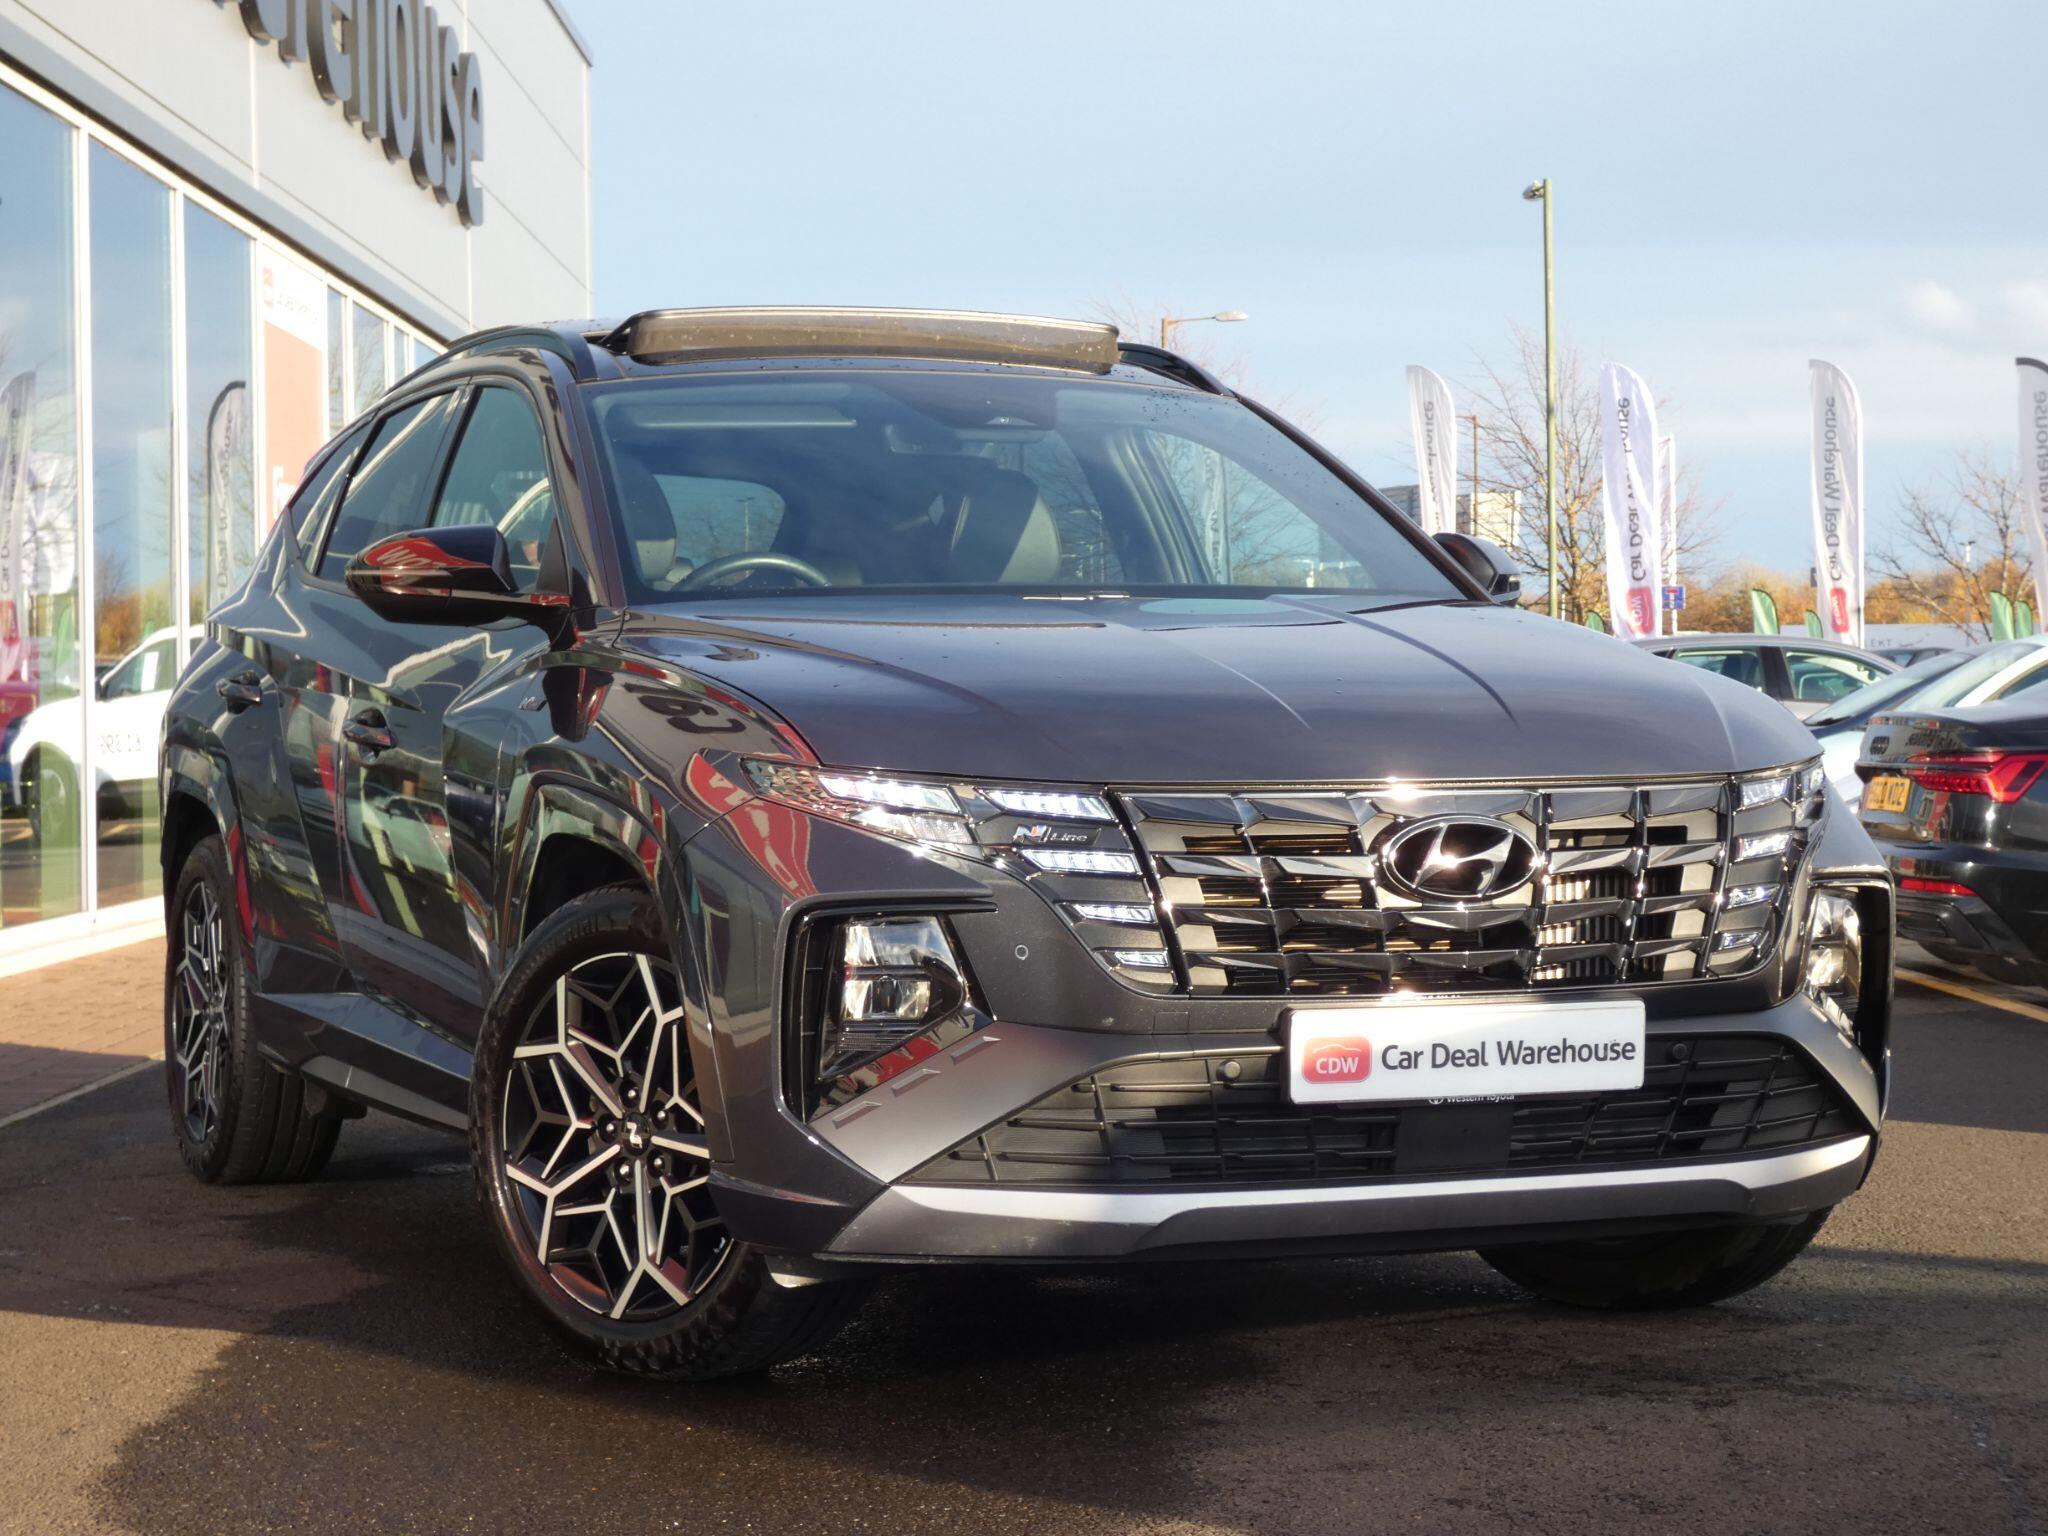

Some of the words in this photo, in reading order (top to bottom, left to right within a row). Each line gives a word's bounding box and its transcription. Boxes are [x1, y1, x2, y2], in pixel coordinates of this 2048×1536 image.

[1315, 1056, 1360, 1076] CDW
[1381, 1044, 1424, 1071] Car
[1431, 1040, 1488, 1069] Deal
[1497, 1038, 1636, 1066] Warehouse
